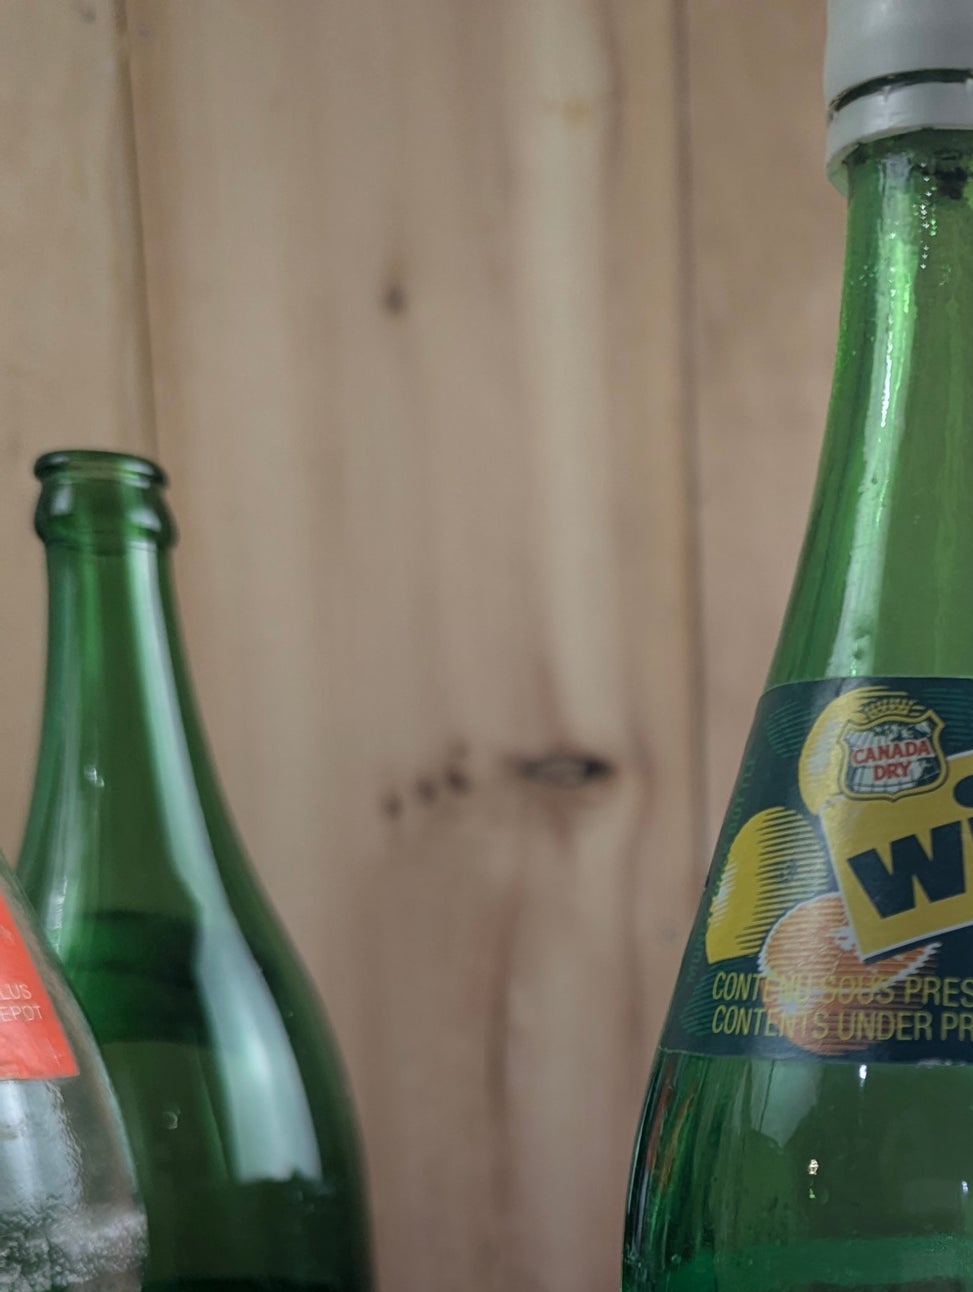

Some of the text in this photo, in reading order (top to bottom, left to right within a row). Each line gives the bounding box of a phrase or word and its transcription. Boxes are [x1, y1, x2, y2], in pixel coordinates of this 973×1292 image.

[852, 741, 931, 764] CANADA
[873, 761, 911, 781] DRY
[712, 971, 821, 1003] CONTENU
[826, 973, 896, 1005] SOUS
[712, 1004, 830, 1039] CONTENTS
[836, 1010, 933, 1041] UNDER
